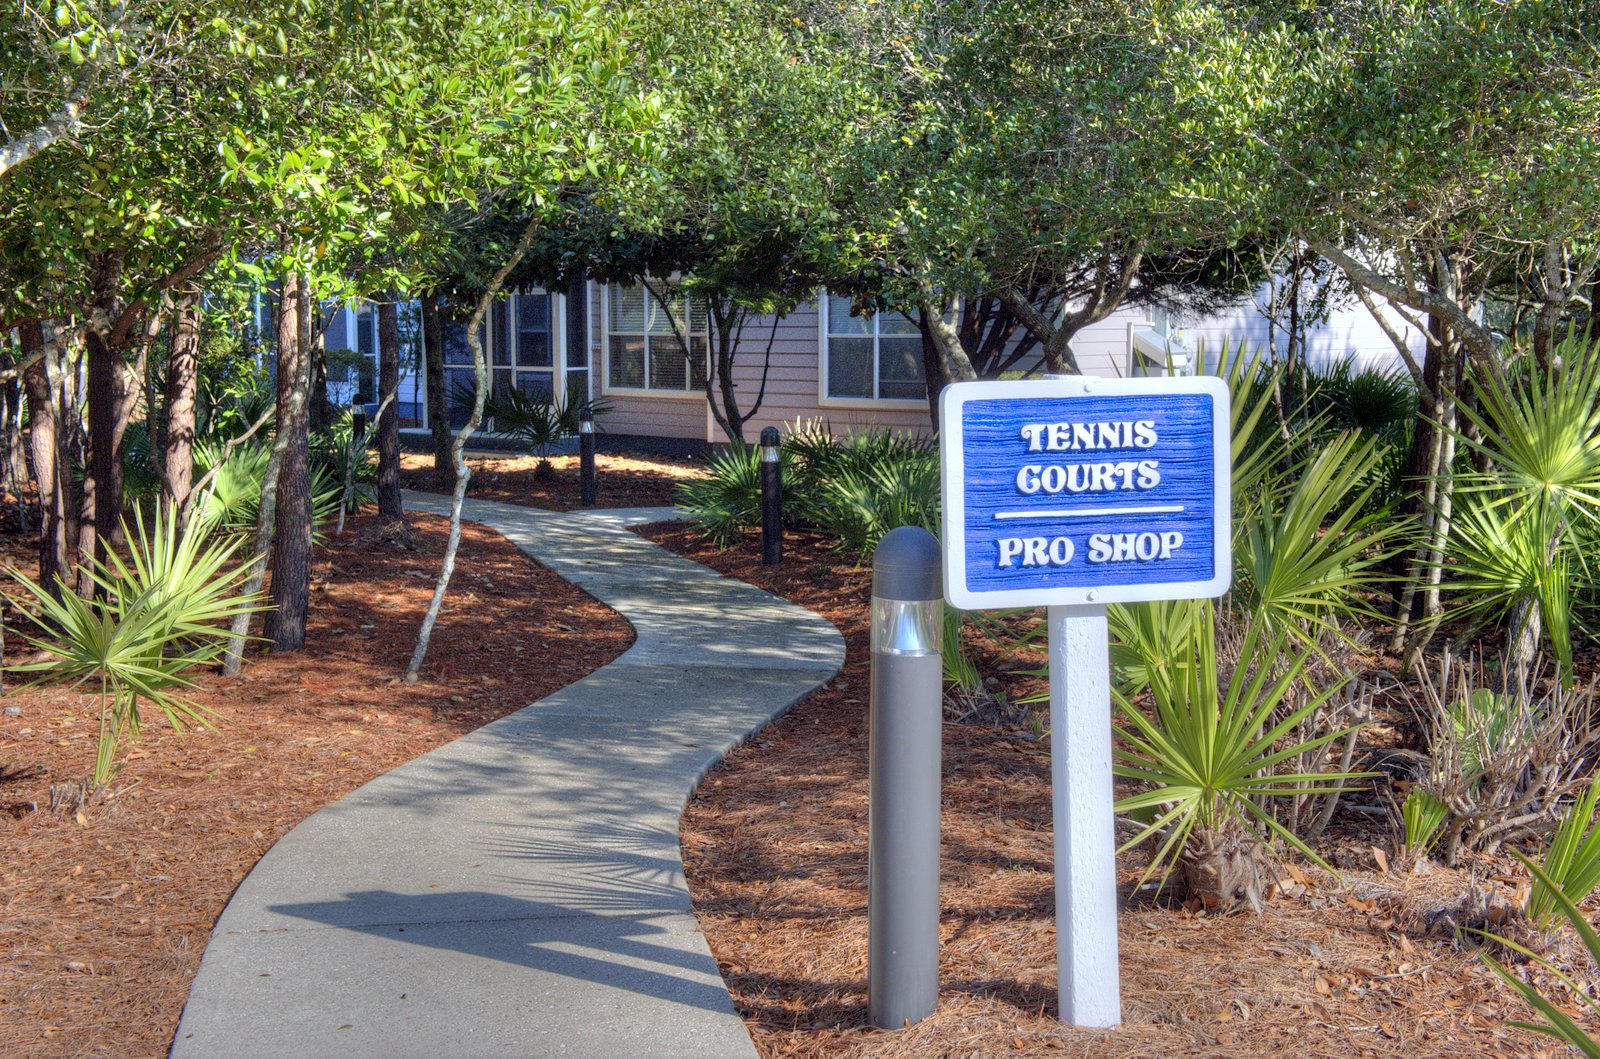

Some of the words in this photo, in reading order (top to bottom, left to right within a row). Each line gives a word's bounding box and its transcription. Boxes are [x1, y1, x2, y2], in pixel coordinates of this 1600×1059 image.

[1020, 420, 1158, 451] TENNIS
[1016, 460, 1161, 494] COURTS
[998, 536, 1075, 567] PRO
[1088, 531, 1184, 563] SHOP
